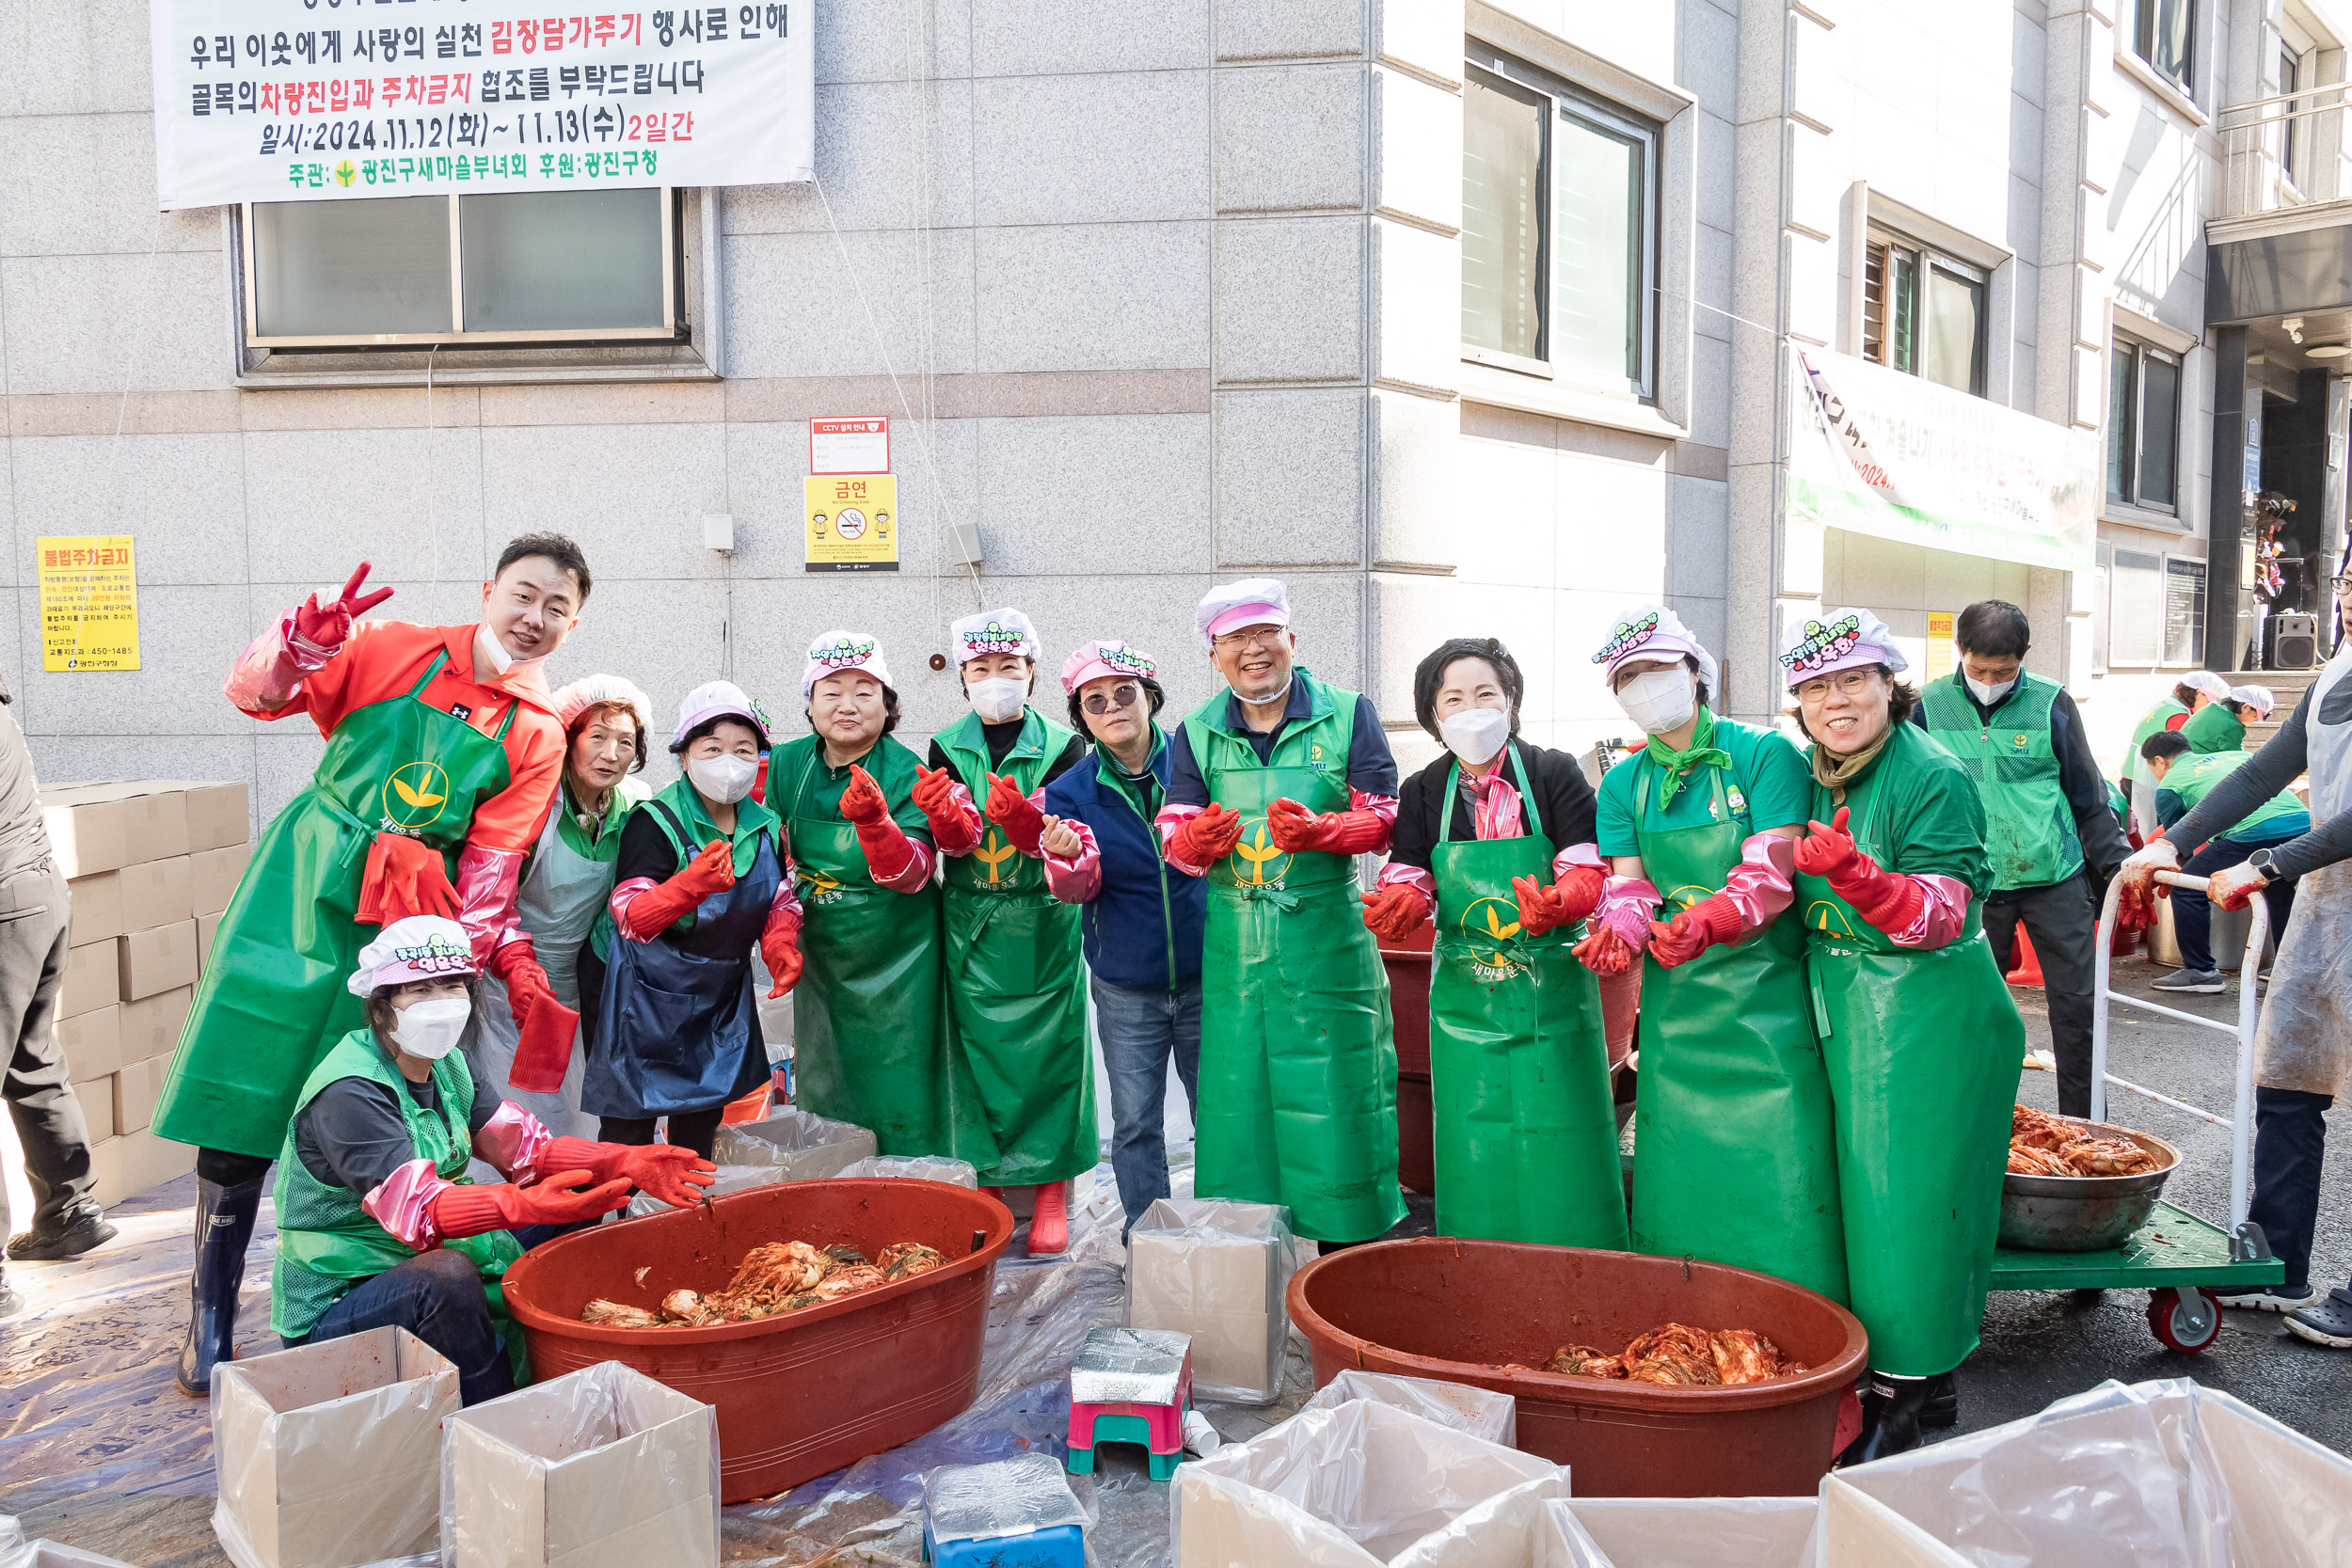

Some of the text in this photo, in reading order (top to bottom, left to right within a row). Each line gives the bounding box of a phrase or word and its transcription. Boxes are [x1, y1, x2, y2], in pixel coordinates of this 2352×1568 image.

[191, 3, 787, 70] 우리 이웃에게 사랑의 실천 김장담가주기 행사로 인해
[382, 72, 472, 107] 주차금지
[481, 67, 550, 103] 협조를
[560, 59, 704, 100] 부탁드립니다
[289, 163, 329, 188] 주관:
[361, 152, 527, 184] 광진구새마을부녀회
[840, 423, 852, 432] 설치
[853, 423, 866, 432] 안내
[835, 481, 866, 499] 금연
[44, 548, 128, 566] 불법주차금지
